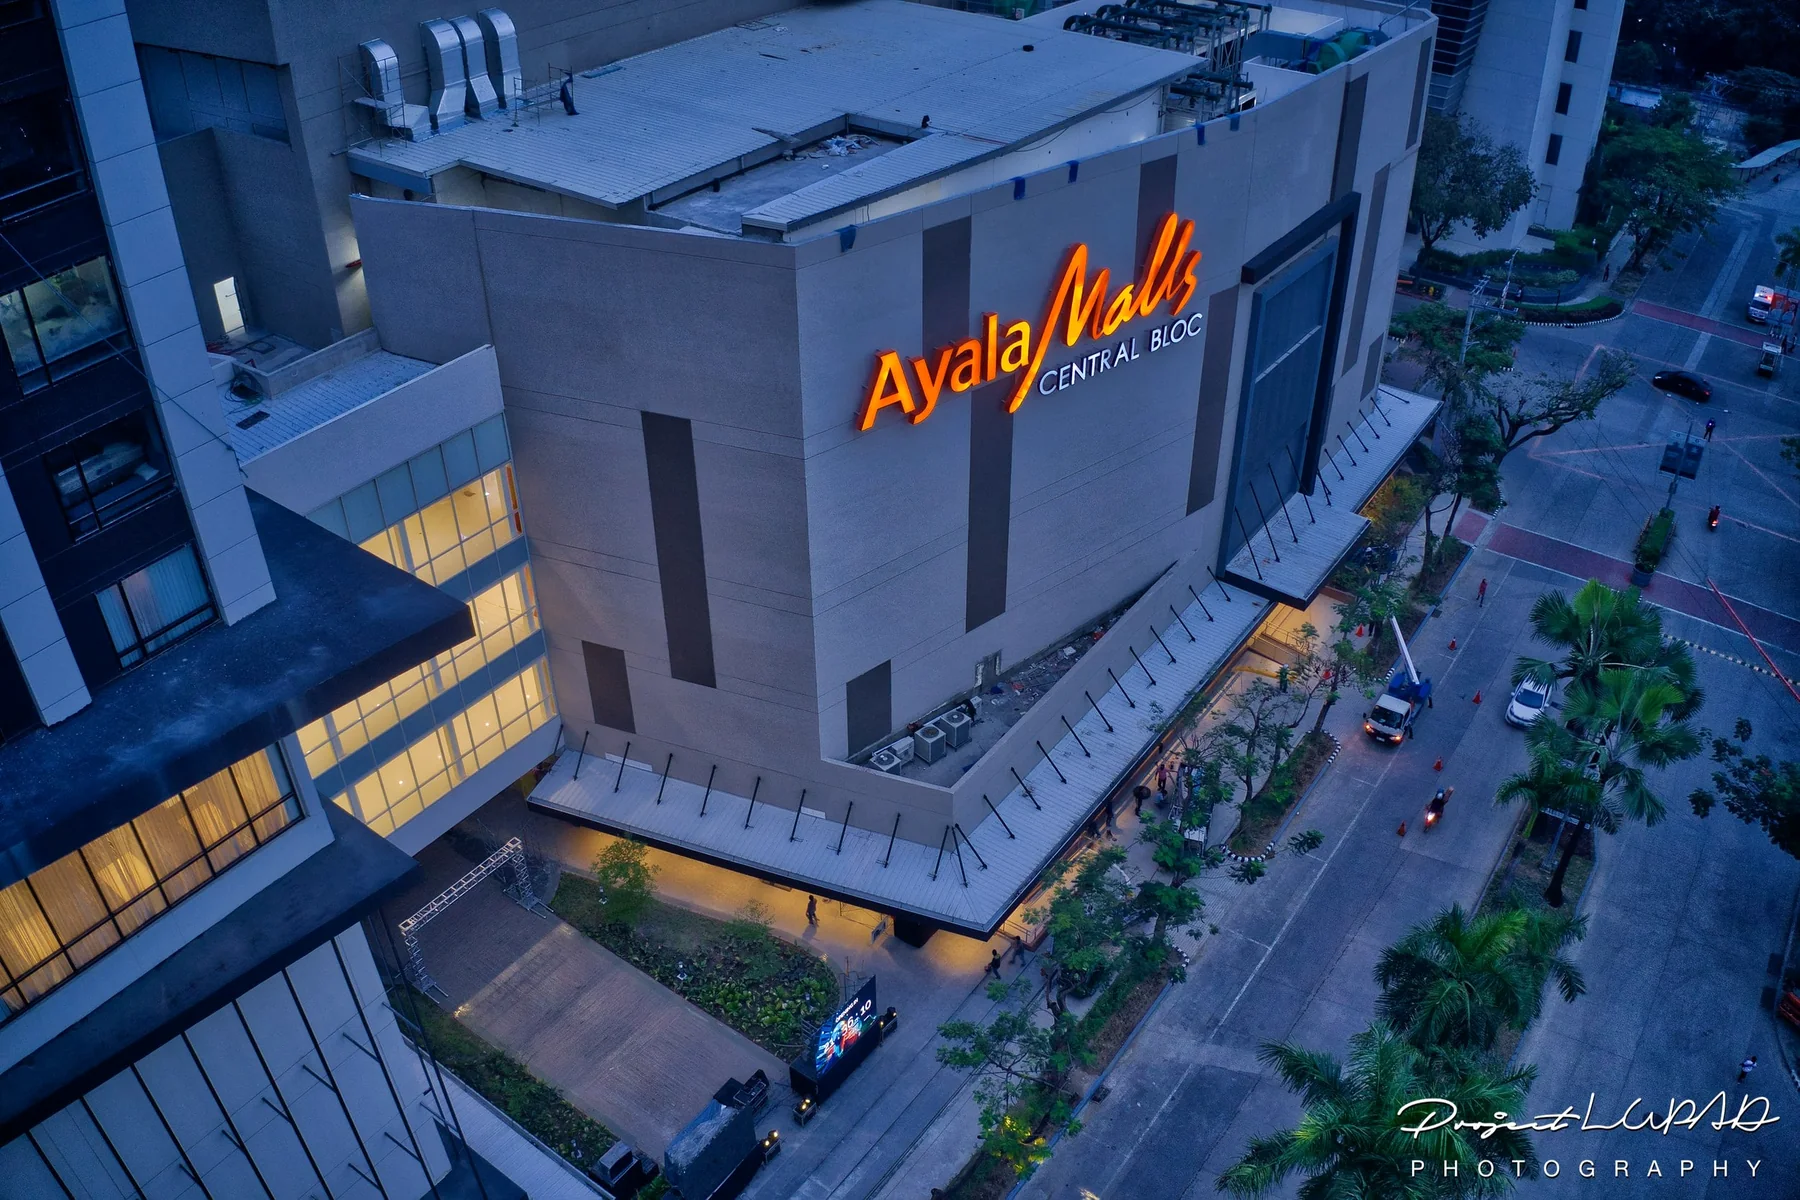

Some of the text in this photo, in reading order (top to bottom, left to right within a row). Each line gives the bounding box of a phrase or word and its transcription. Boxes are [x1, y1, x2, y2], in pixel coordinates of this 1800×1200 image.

[857, 211, 1202, 431] Ayala Malls
[1038, 312, 1203, 396] CENTRAL BLOC
